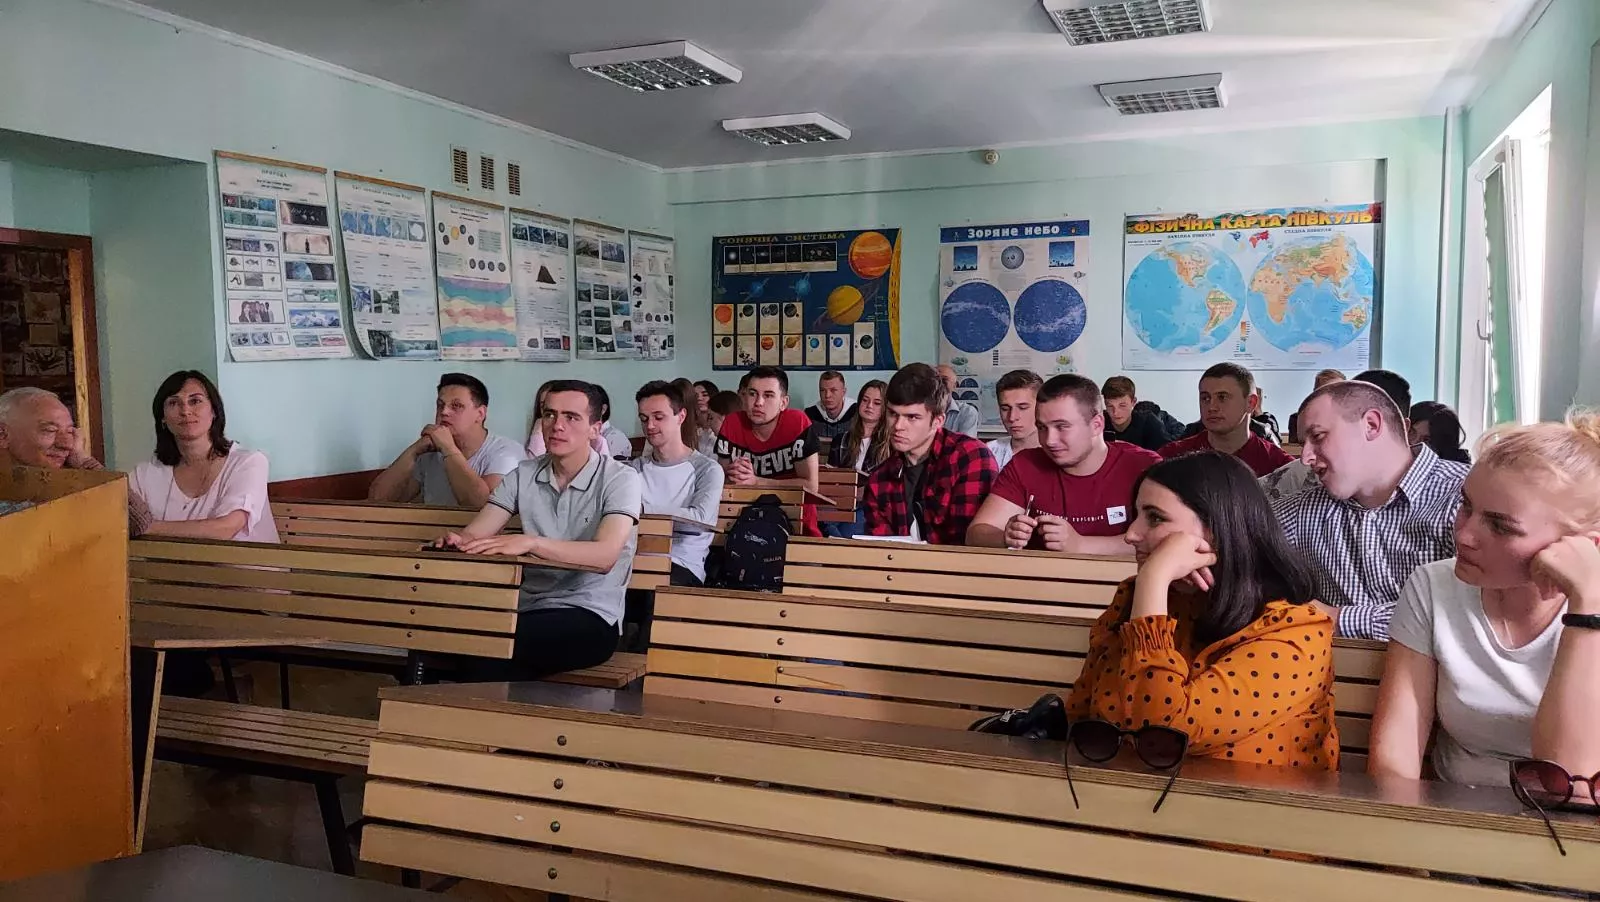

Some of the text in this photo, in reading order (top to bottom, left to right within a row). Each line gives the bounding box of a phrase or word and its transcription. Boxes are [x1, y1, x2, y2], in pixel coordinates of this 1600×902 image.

[1134, 210, 1373, 233] ФІЗИЧНА КАРТА ПІВКУЛЬ
[718, 232, 846, 245] СОНЯЧНА СИСТЕМА
[967, 225, 1060, 239] Зоряне небо
